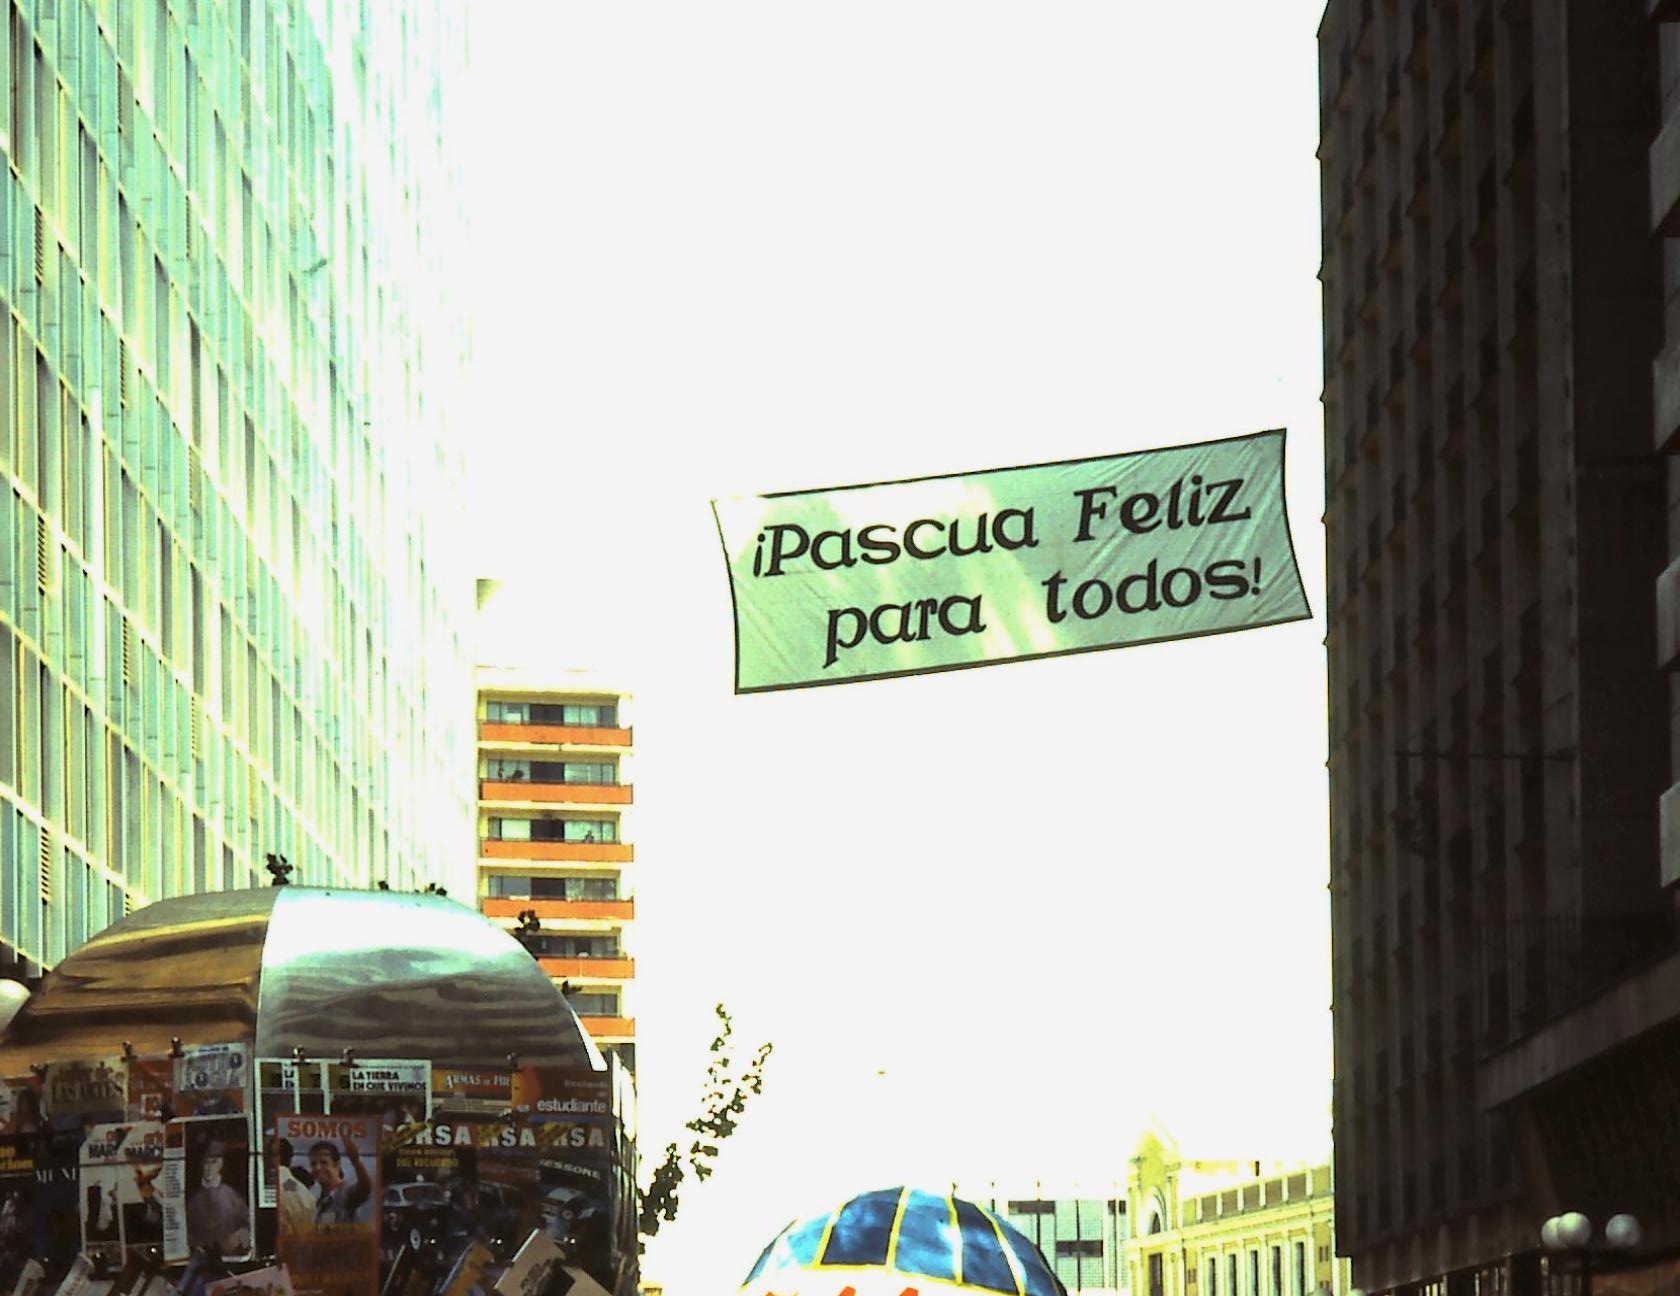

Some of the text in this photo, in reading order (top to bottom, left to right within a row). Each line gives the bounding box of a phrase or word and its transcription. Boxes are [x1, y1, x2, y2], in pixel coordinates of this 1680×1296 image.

[752, 474, 1252, 578] ¡Pascua Feliz
[822, 556, 1262, 669] para todos!
[445, 1074, 481, 1088] ARMAS
[536, 1098, 607, 1113] estudiante
[287, 1120, 368, 1138] SOMOS
